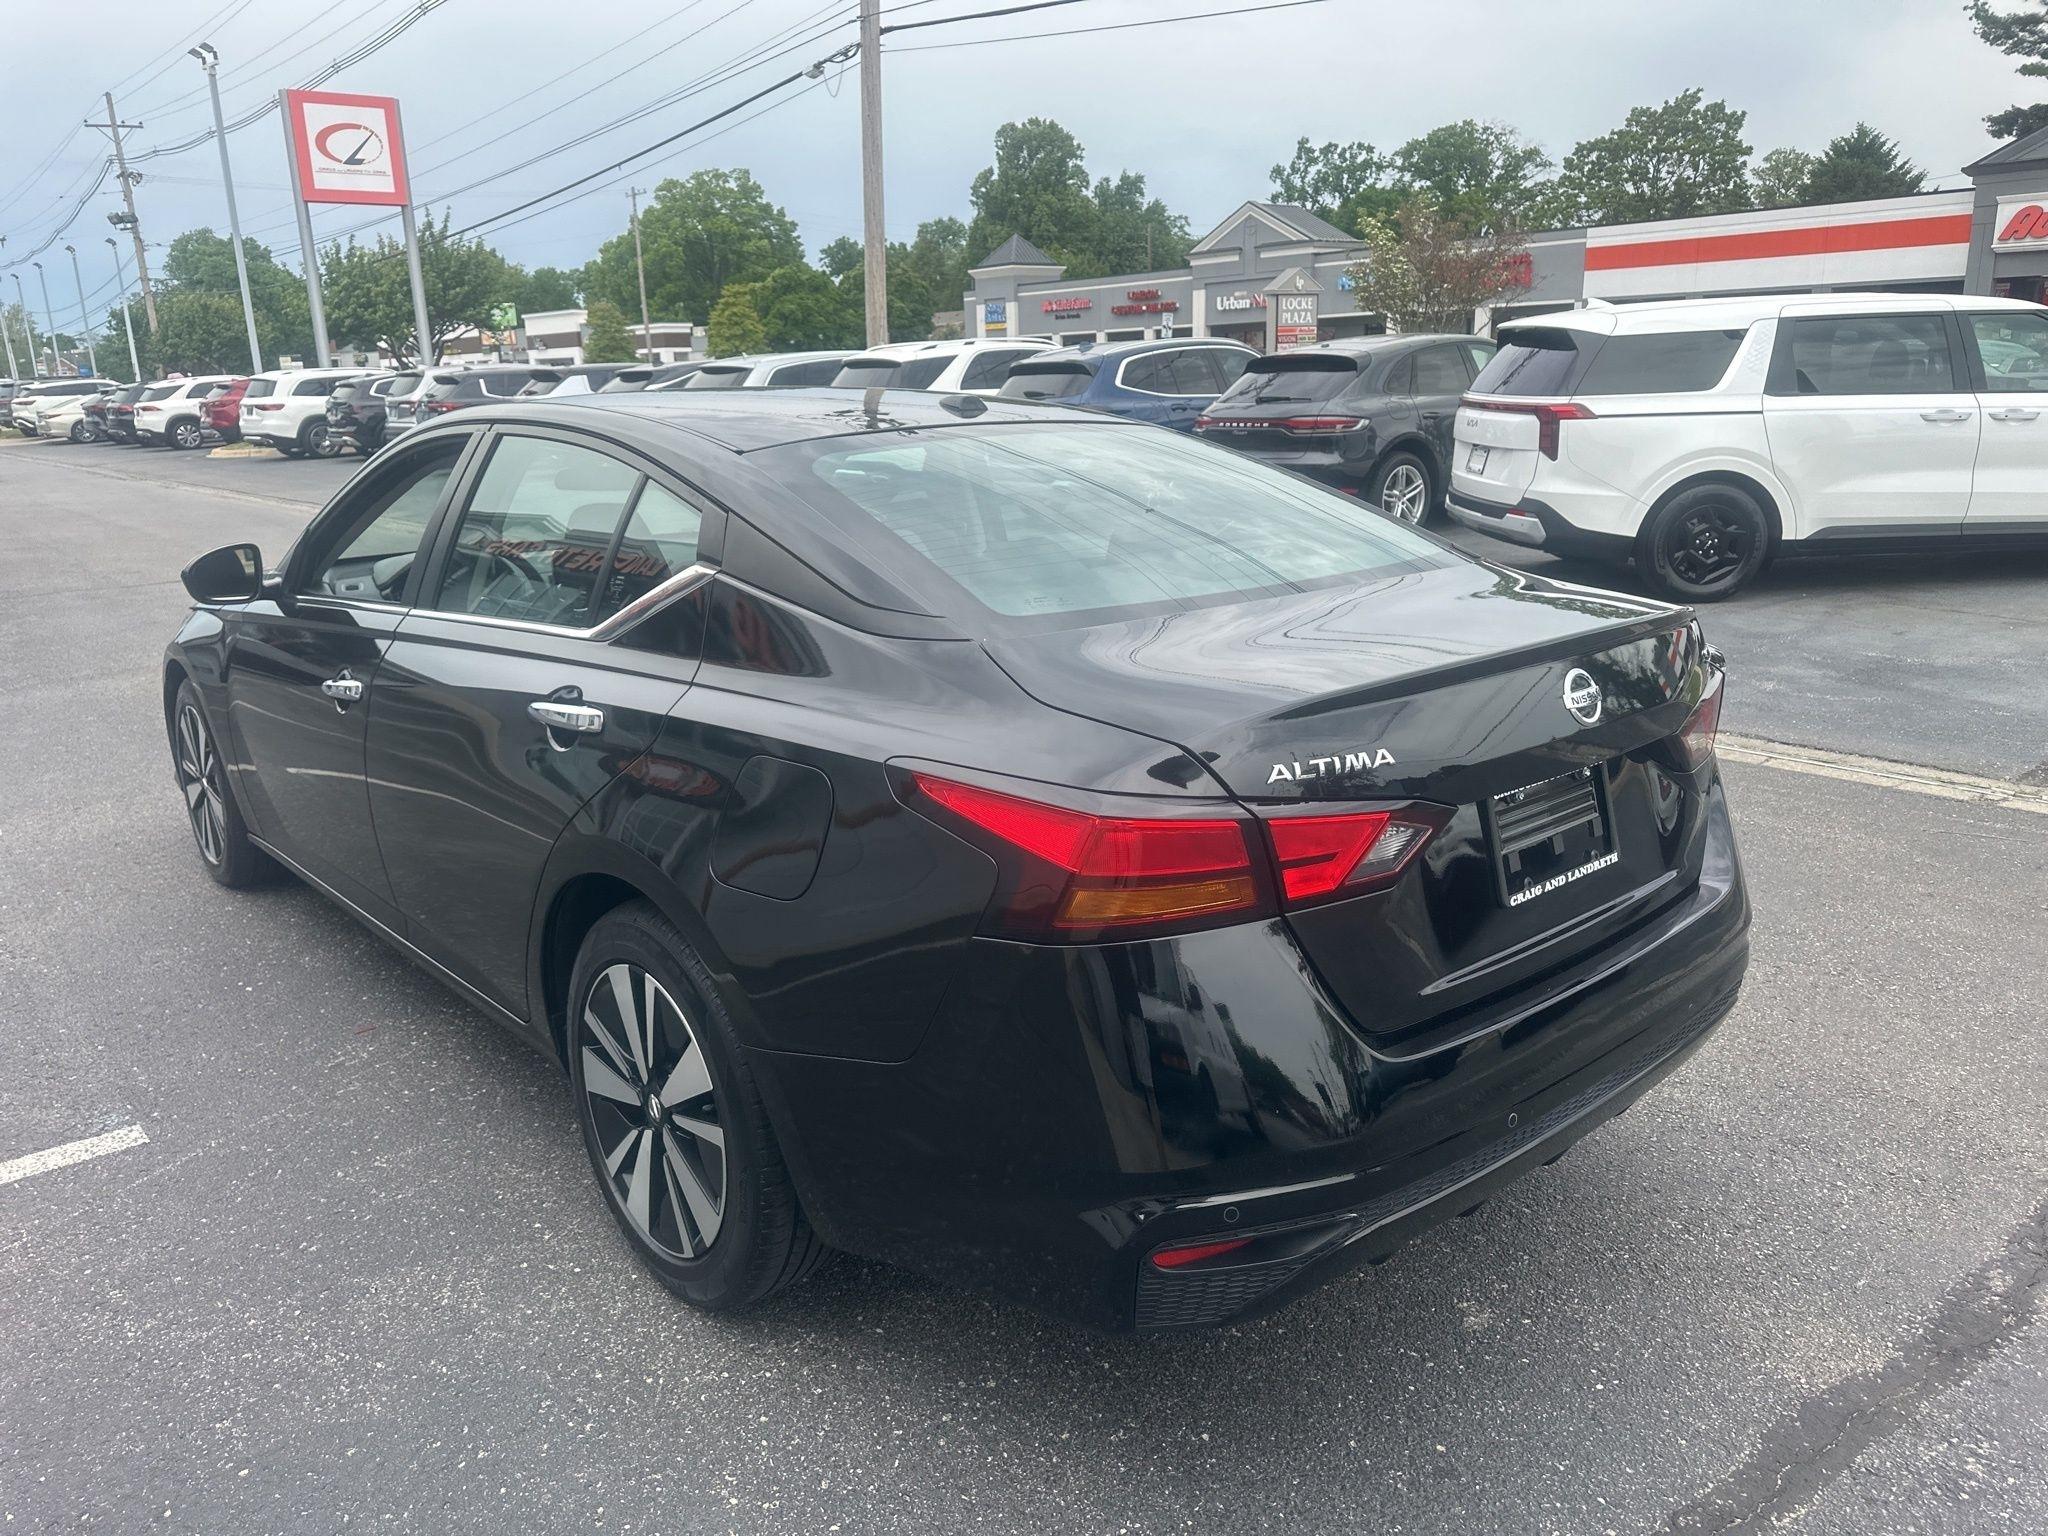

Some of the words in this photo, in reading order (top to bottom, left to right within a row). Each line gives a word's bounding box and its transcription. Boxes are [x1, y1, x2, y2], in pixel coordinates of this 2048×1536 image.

[1216, 296, 1251, 311] Urban
[1282, 297, 1313, 310] LOCKE
[1282, 311, 1313, 324] PLAZA
[1570, 686, 1601, 706] NISSAN
[1266, 748, 1397, 785] ALTIMA
[1510, 885, 1543, 907] CRAIG
[1544, 875, 1566, 892] AND
[1567, 852, 1620, 882] LANDRETH
